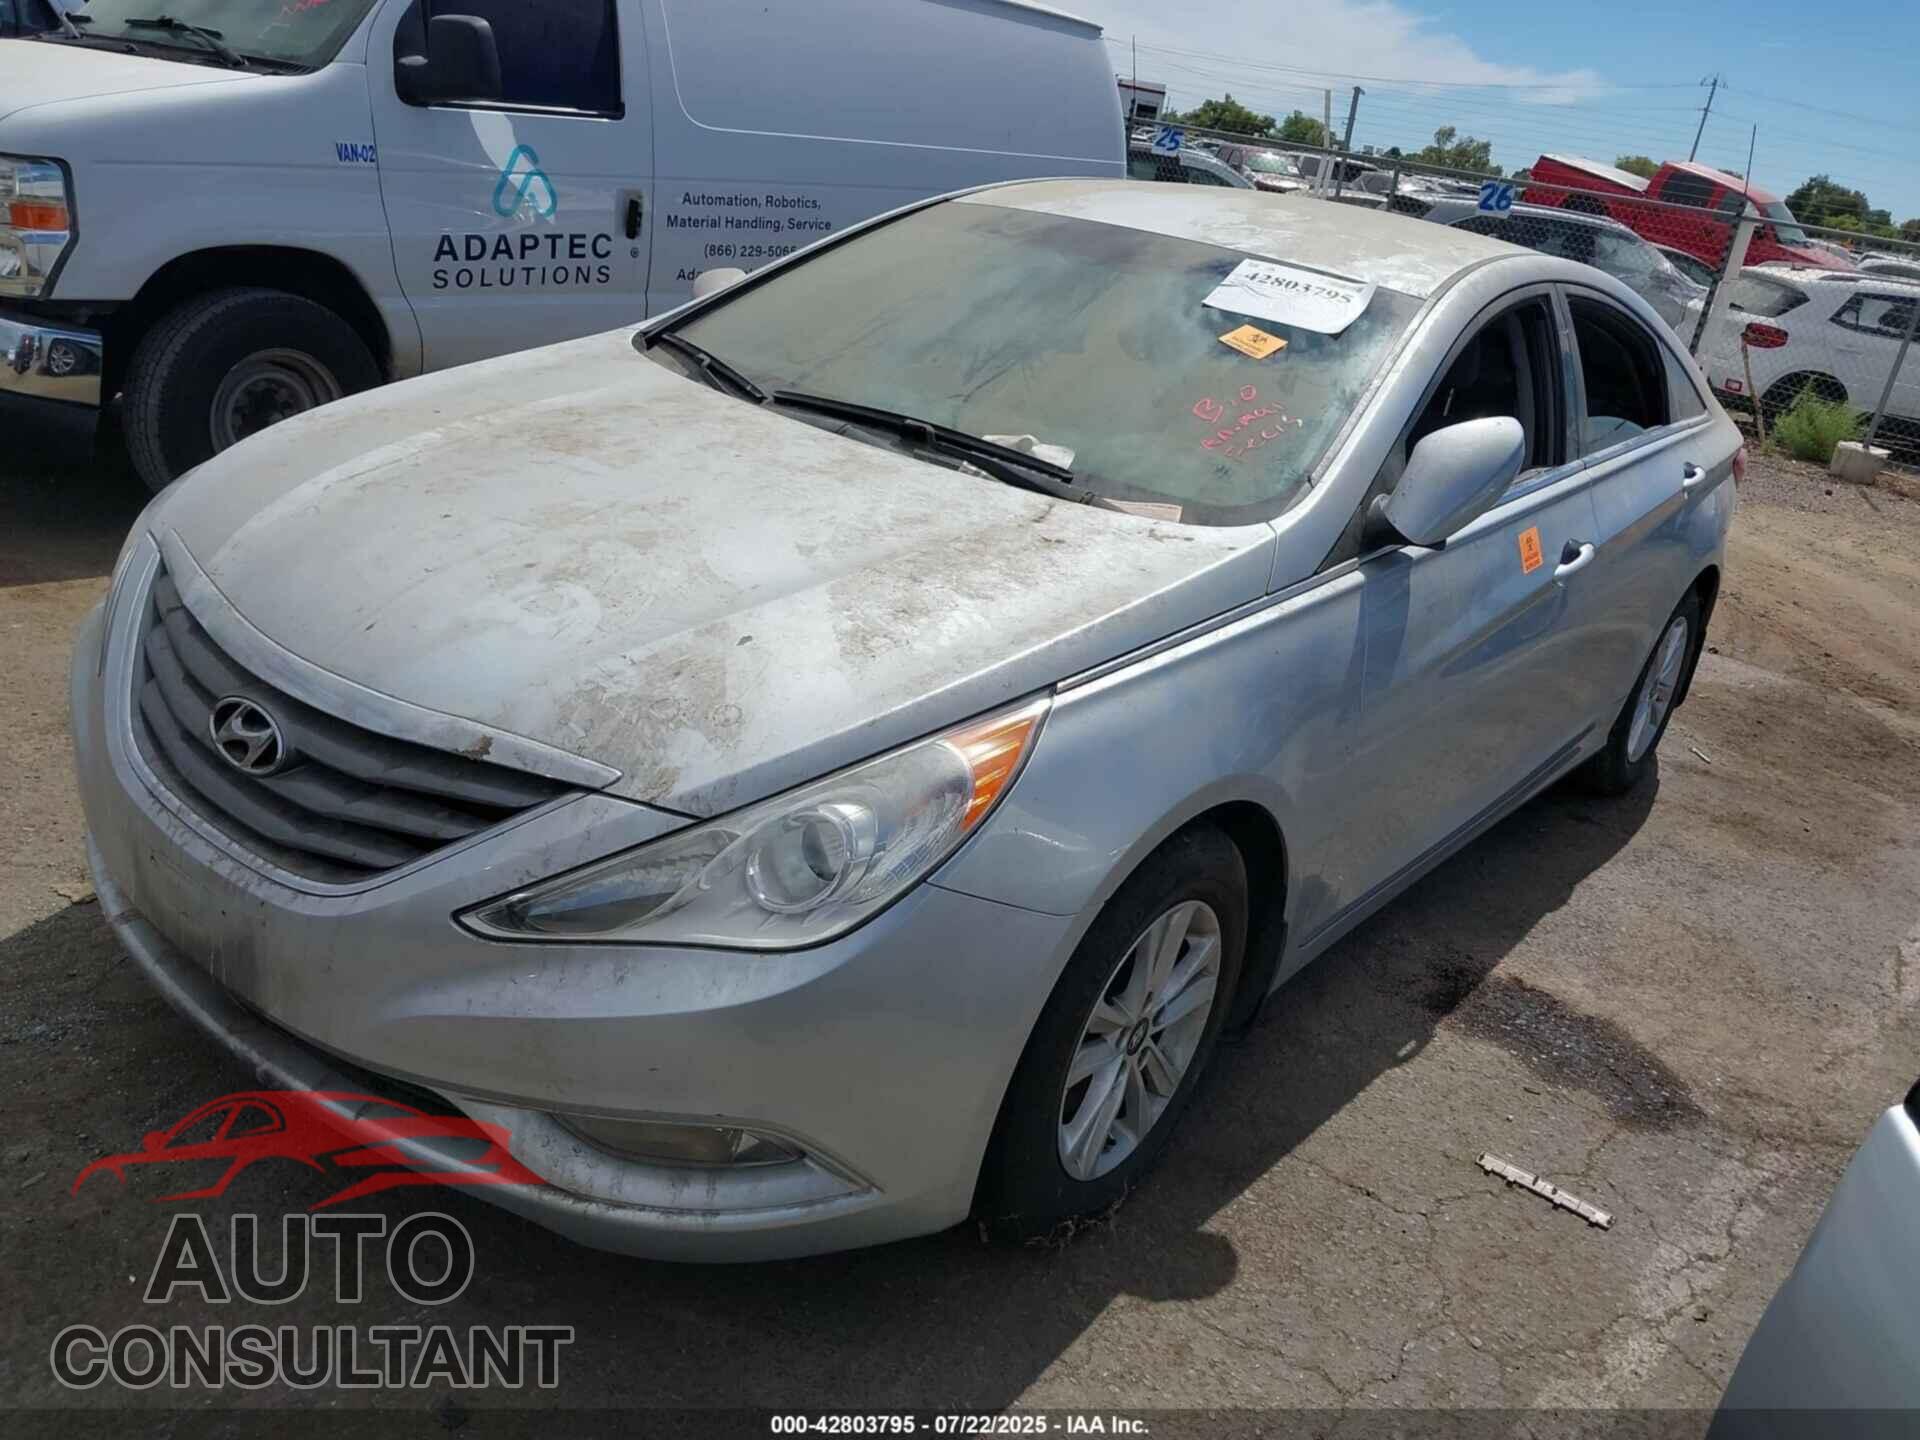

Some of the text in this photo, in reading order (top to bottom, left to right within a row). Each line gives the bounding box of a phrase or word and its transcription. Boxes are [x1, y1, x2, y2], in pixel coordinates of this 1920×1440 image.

[1155, 126, 1184, 152] 25
[336, 142, 376, 163] VAN-02
[681, 191, 821, 210] Automation, Robotics,
[1479, 183, 1512, 211] 26
[666, 213, 832, 232] Material Handling, Service
[433, 233, 613, 262] ADAPTEC
[704, 243, 737, 258] (866)
[432, 265, 611, 289] SOLUTIONS
[1245, 272, 1355, 304] 42803795
